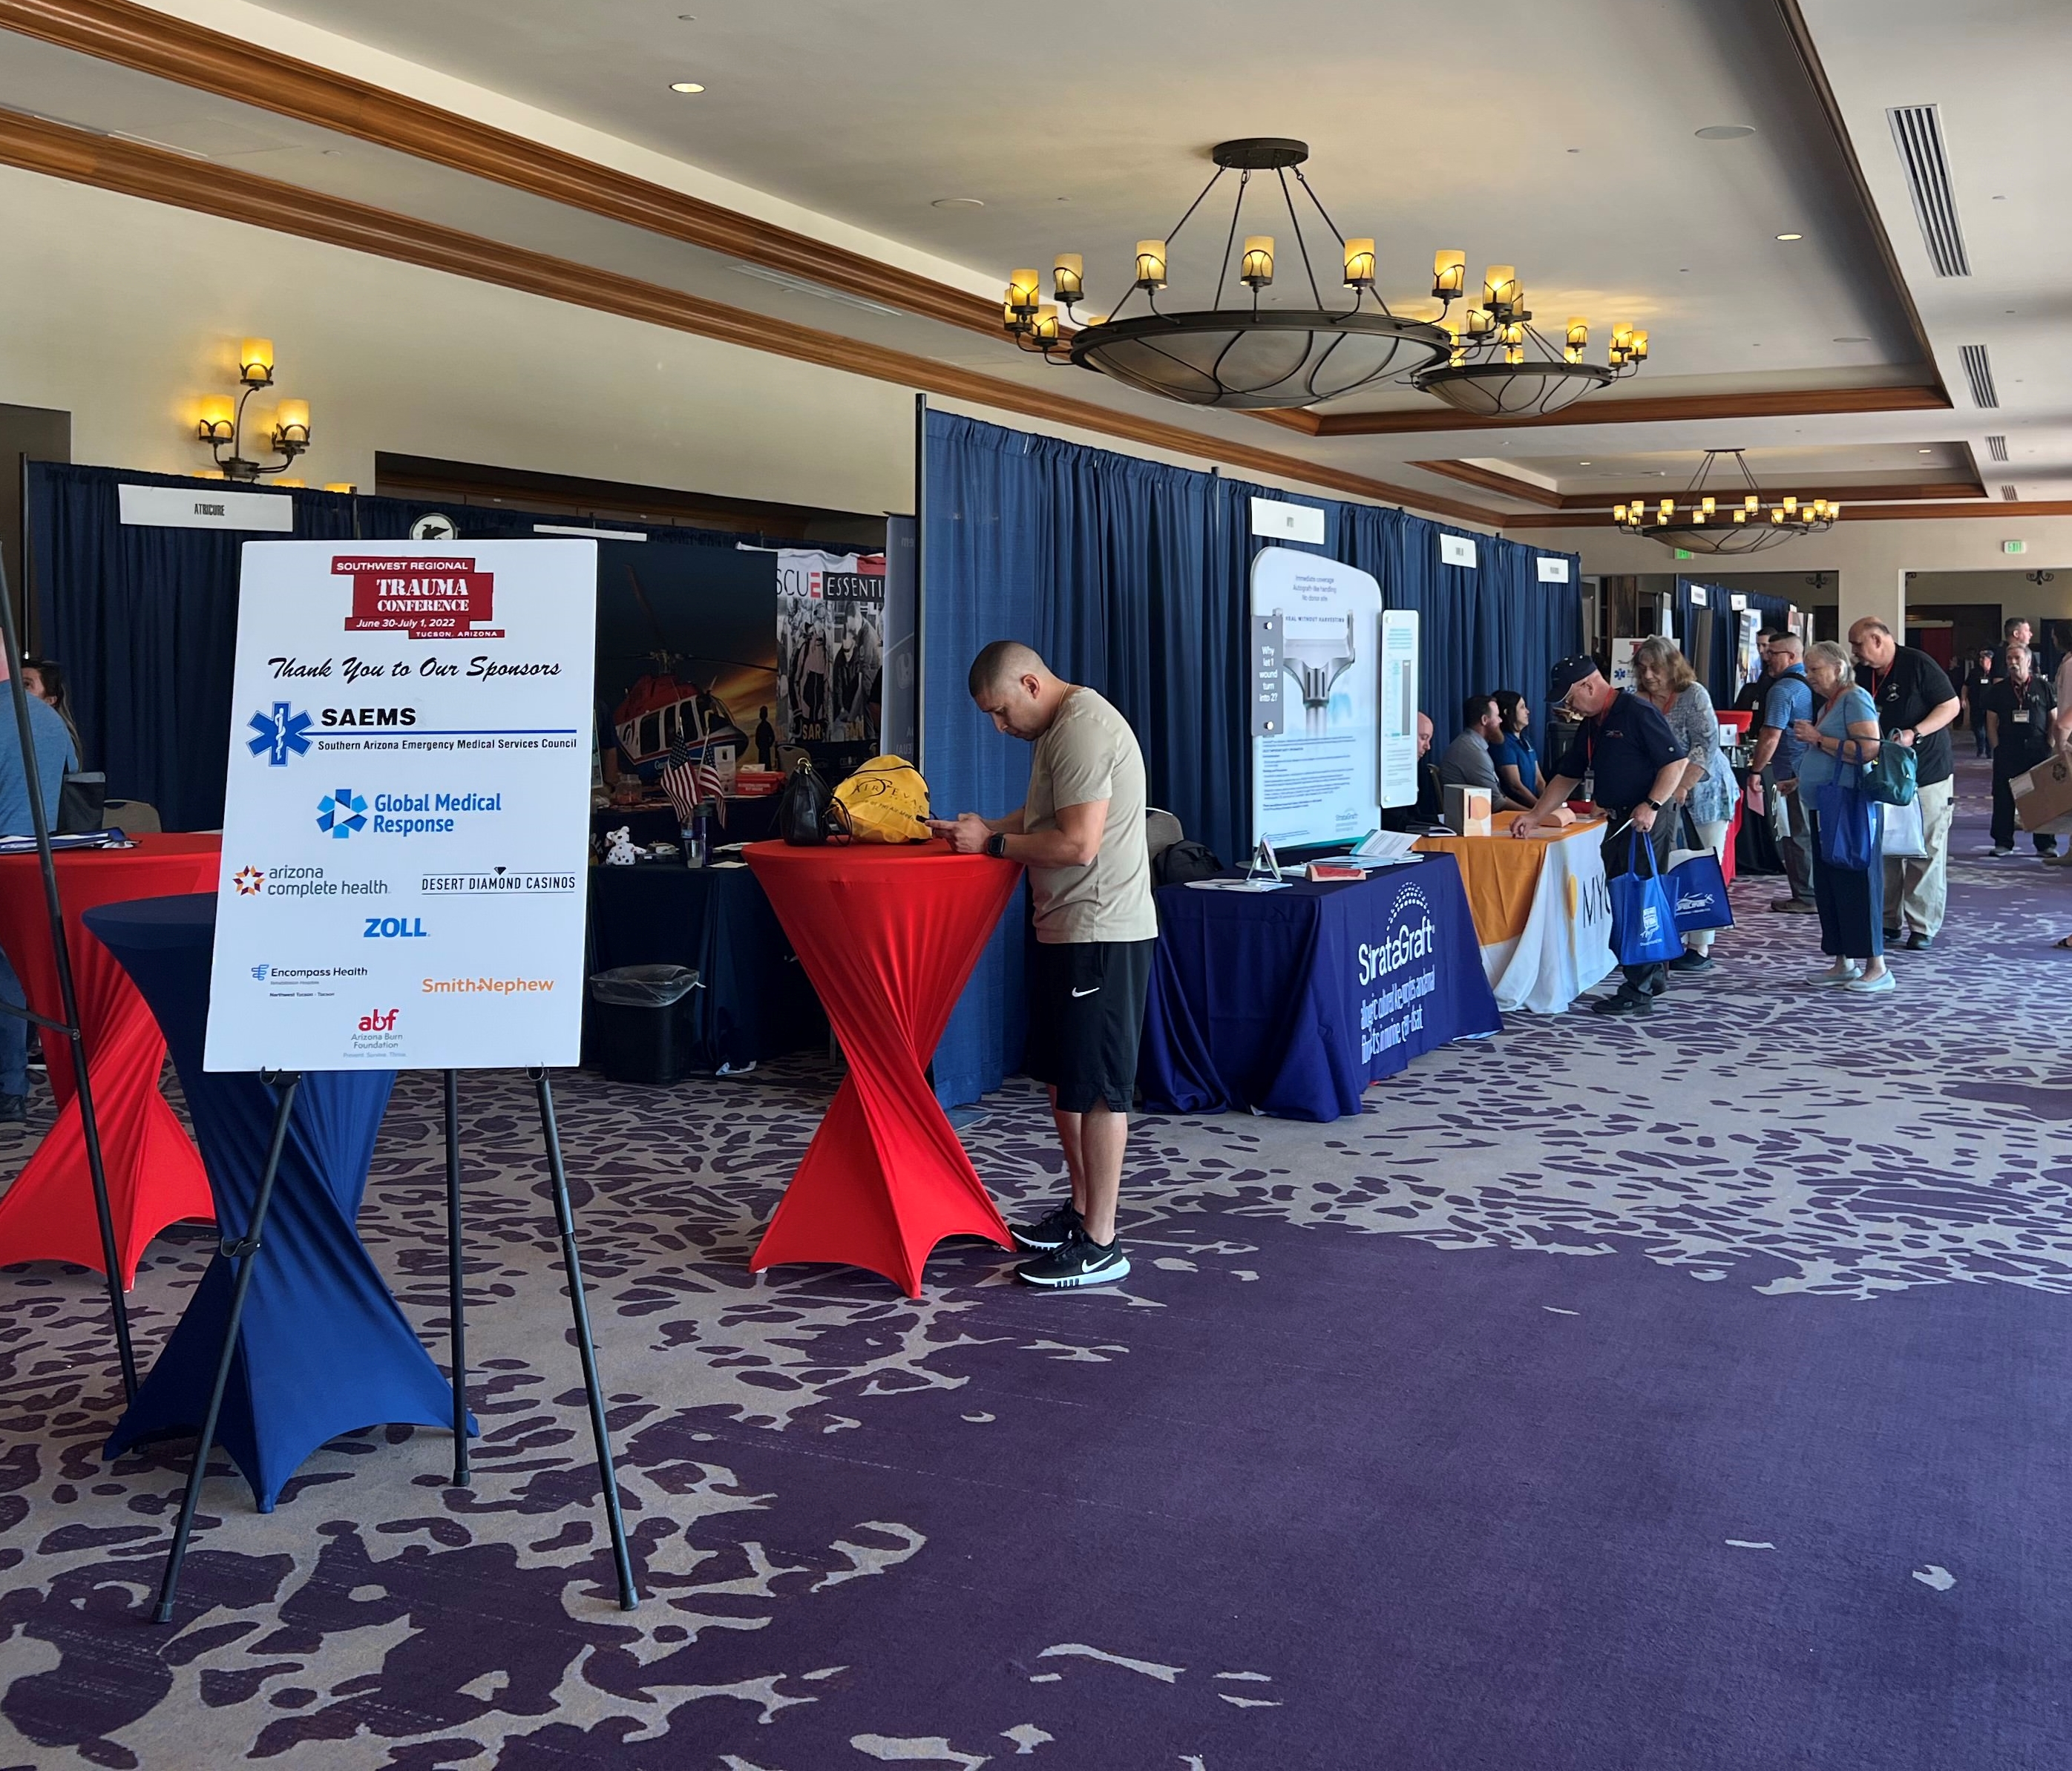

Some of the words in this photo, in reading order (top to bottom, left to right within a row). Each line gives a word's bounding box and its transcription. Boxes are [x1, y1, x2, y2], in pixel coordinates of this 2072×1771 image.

[336, 562, 407, 571] SOUTHWEST
[410, 562, 468, 570] REGIONAL
[376, 579, 468, 597] TRAUMA
[377, 599, 469, 612] CONFERENCE
[356, 620, 380, 628] June
[382, 619, 418, 629] 30-July
[429, 619, 455, 627] 2022
[268, 657, 332, 679] Thank
[341, 657, 384, 684] You
[391, 661, 412, 677] to
[419, 657, 459, 677] Our
[465, 656, 562, 682] Sponsors
[321, 708, 416, 726] SAEMS
[318, 741, 361, 751] Southern
[364, 740, 399, 750] Arizona
[402, 740, 454, 752] Emergency
[457, 739, 495, 749] Medical
[498, 739, 539, 749] Services
[542, 738, 577, 749] Council
[375, 794, 430, 812] Global
[435, 793, 502, 811] Medical
[373, 815, 454, 838] Response
[269, 864, 324, 879] arizona
[267, 880, 337, 898] complete
[341, 879, 388, 895] health
[422, 878, 464, 890] DESERT
[469, 877, 521, 890] DIAMOND
[526, 876, 575, 889] CASINOS
[363, 917, 427, 938] ZOLL
[1358, 916, 1433, 986] StrataGraft
[271, 967, 331, 979] Encompass
[333, 967, 368, 976] Health
[358, 1008, 400, 1031] abf
